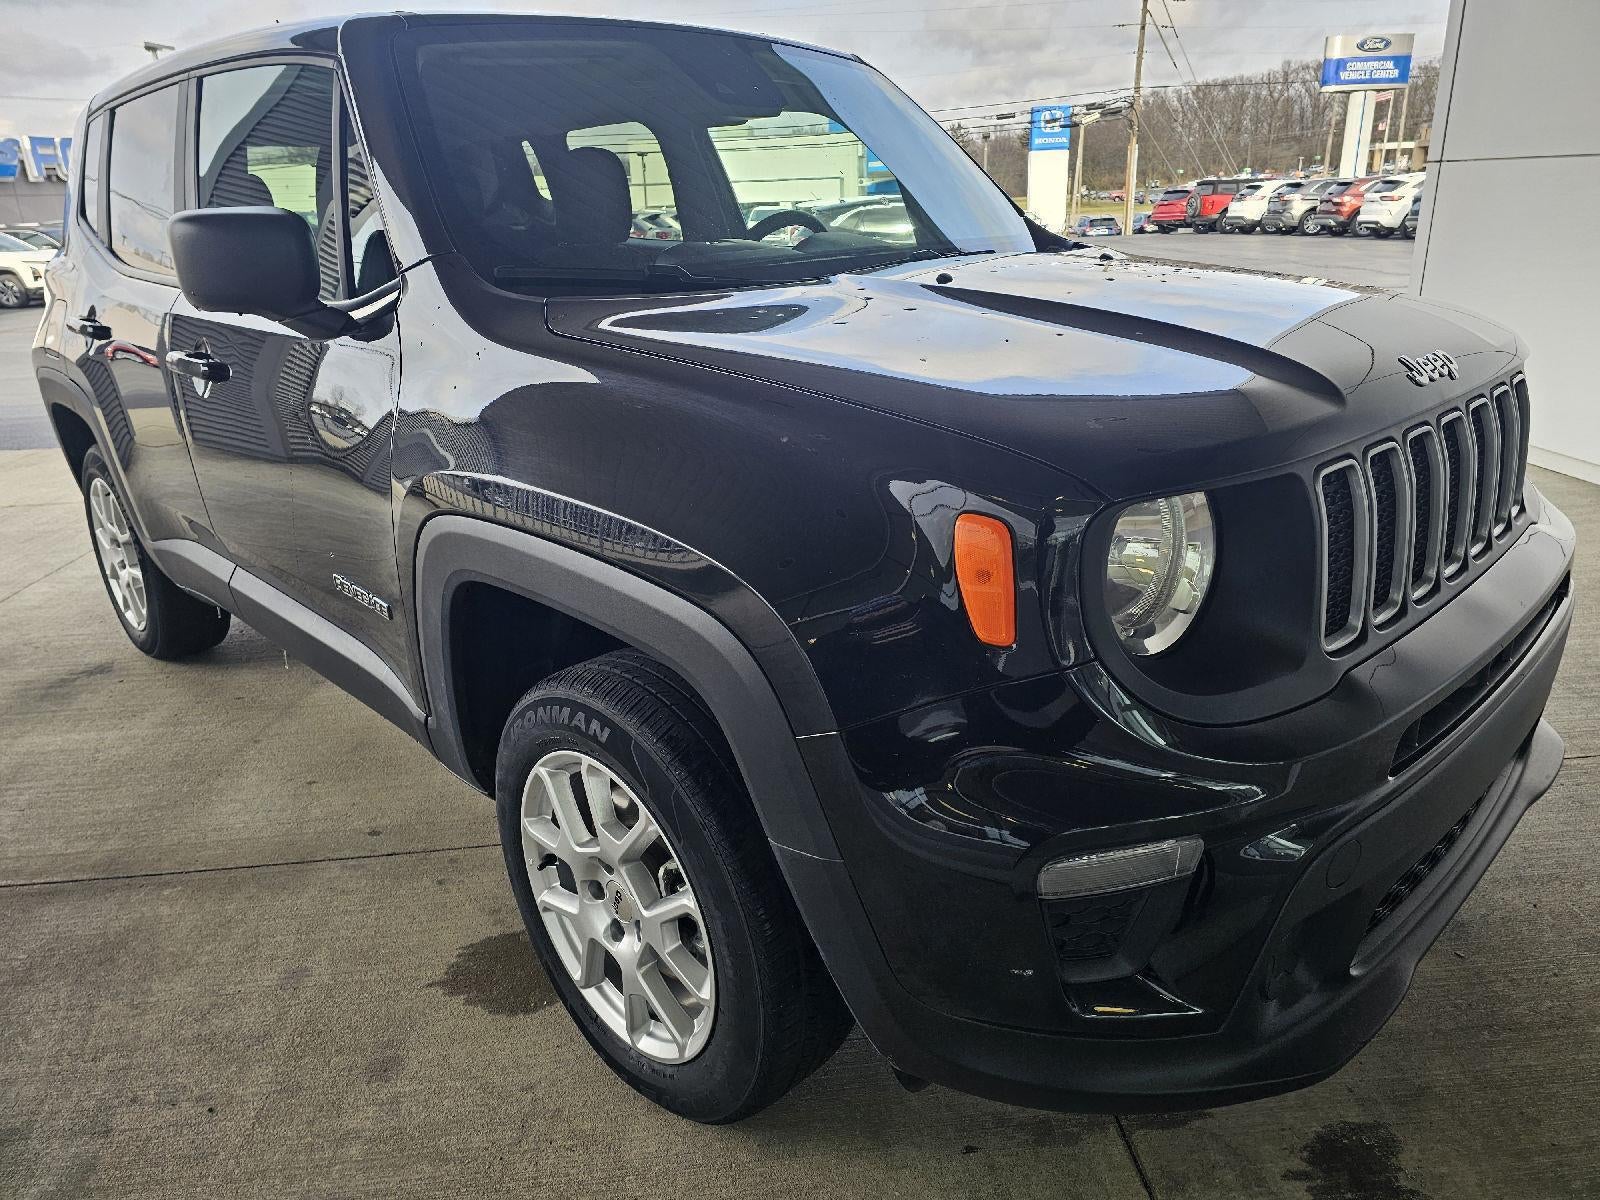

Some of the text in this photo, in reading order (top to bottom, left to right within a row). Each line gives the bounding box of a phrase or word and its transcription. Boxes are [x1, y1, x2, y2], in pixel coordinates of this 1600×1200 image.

[1363, 38, 1387, 50] Ford
[1346, 60, 1395, 71] COMMERCIAL
[1339, 69, 1399, 80] VEHICLE CENTER
[1034, 137, 1067, 145] HONDA
[1397, 349, 1459, 387] Jeep
[332, 573, 392, 620] RENEGADE
